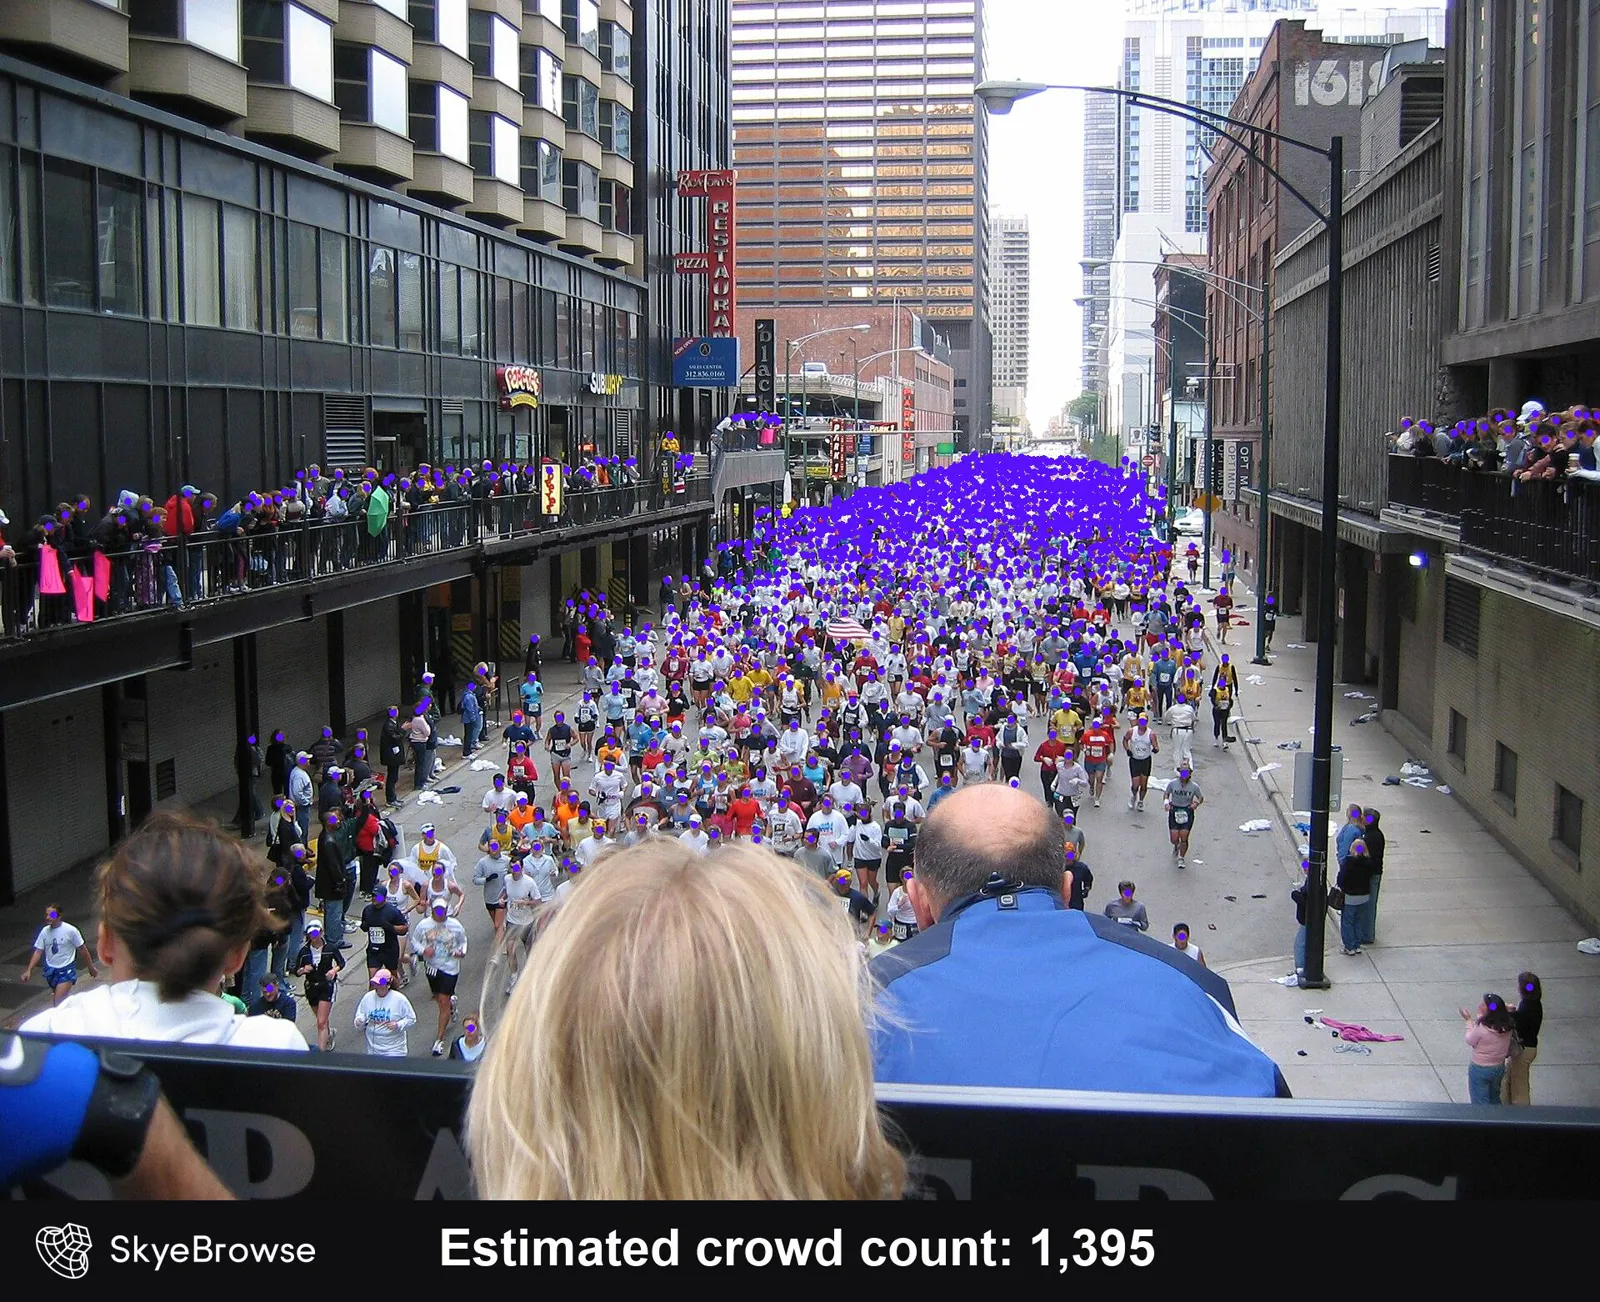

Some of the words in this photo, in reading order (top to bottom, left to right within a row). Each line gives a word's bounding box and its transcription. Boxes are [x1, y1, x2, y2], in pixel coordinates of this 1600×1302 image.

[676, 258, 709, 269] PIZZA
[713, 201, 731, 338] RESTAURAN
[590, 372, 623, 396] SUBWAY
[661, 460, 670, 495] SUBWAY
[1228, 446, 1236, 496] OPTIMUS
